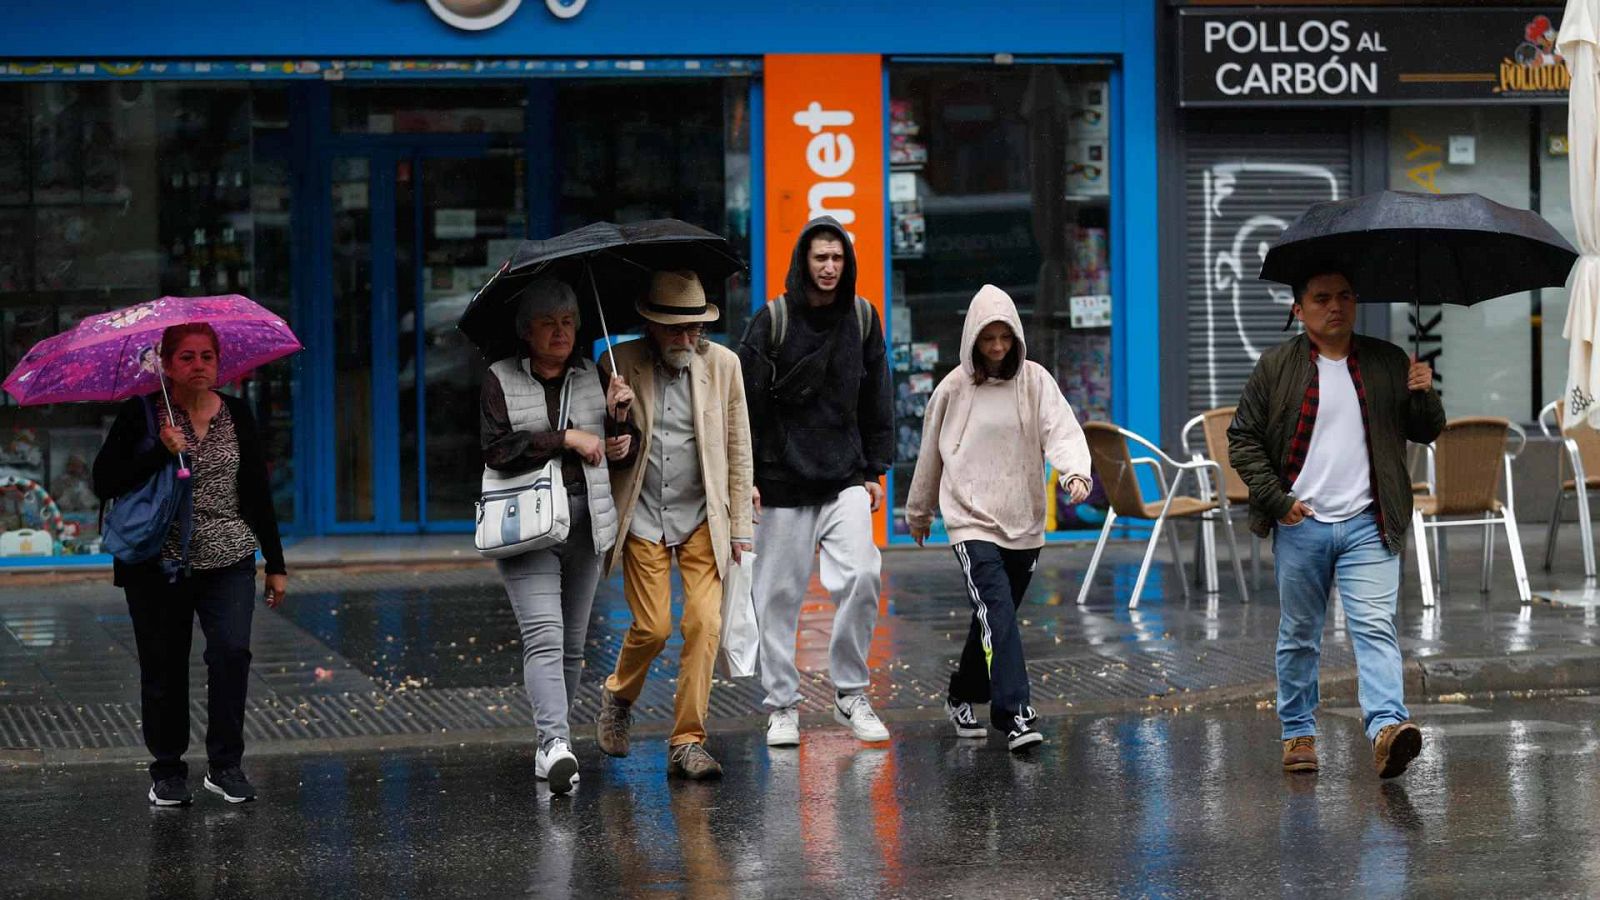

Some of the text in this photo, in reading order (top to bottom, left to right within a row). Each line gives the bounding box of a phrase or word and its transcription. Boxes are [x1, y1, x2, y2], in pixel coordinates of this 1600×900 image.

[1204, 20, 1388, 53] POLLOS AL
[1215, 55, 1378, 95] CARBÓN
[792, 101, 856, 243] net
